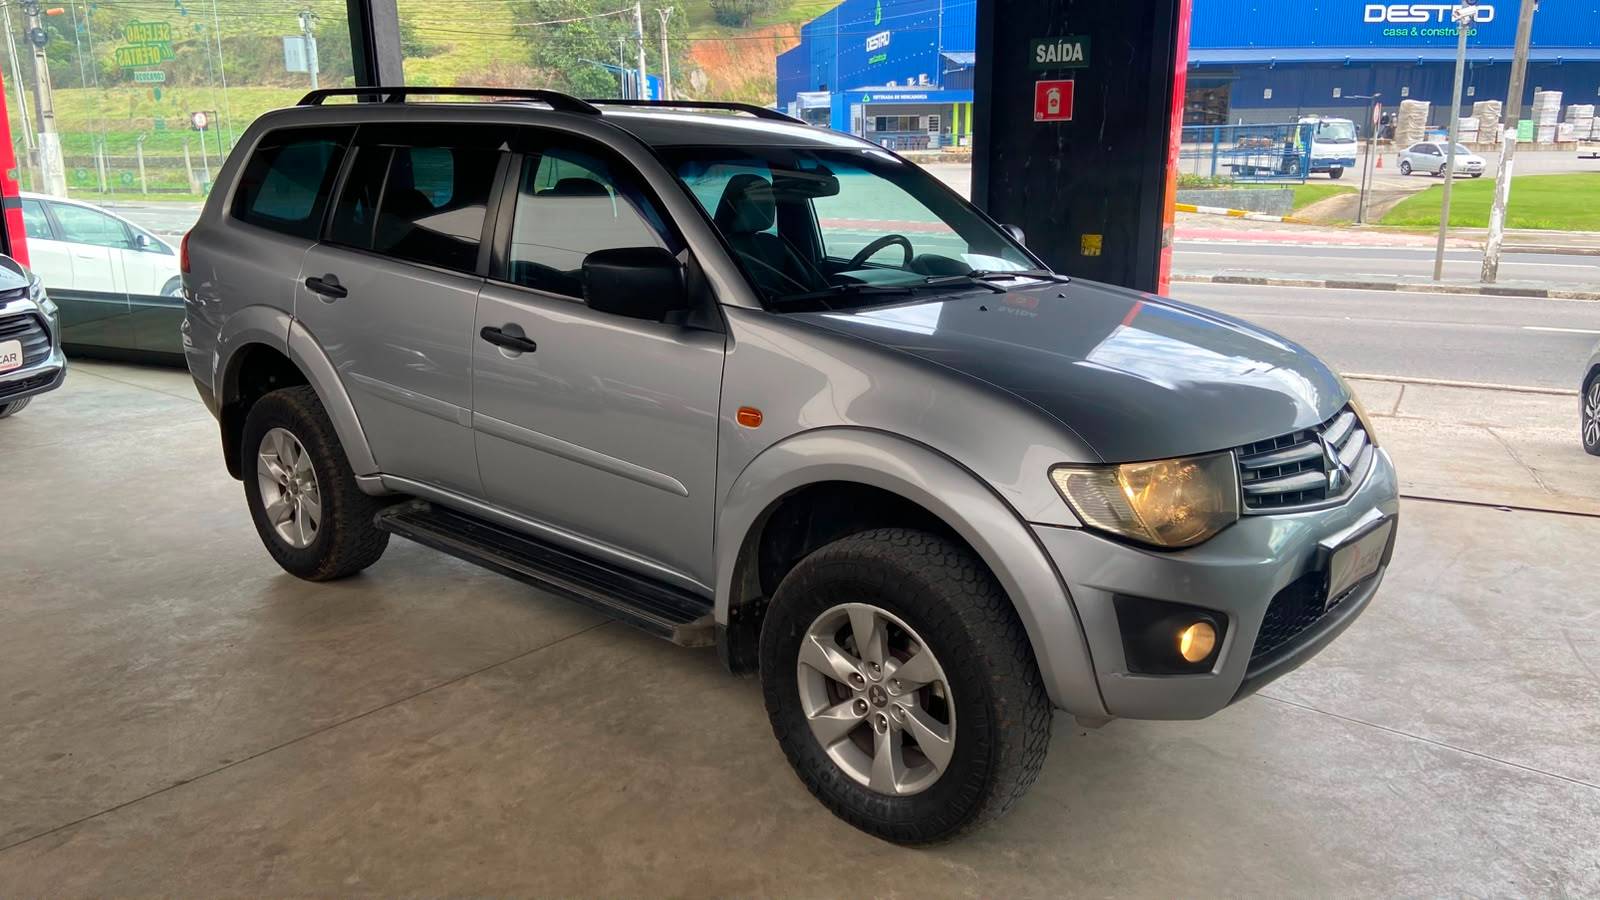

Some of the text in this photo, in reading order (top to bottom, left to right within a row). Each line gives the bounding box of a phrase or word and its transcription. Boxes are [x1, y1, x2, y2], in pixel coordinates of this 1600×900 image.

[1383, 27, 1477, 36] casa & construão
[1035, 39, 1084, 63] SAÍDA
